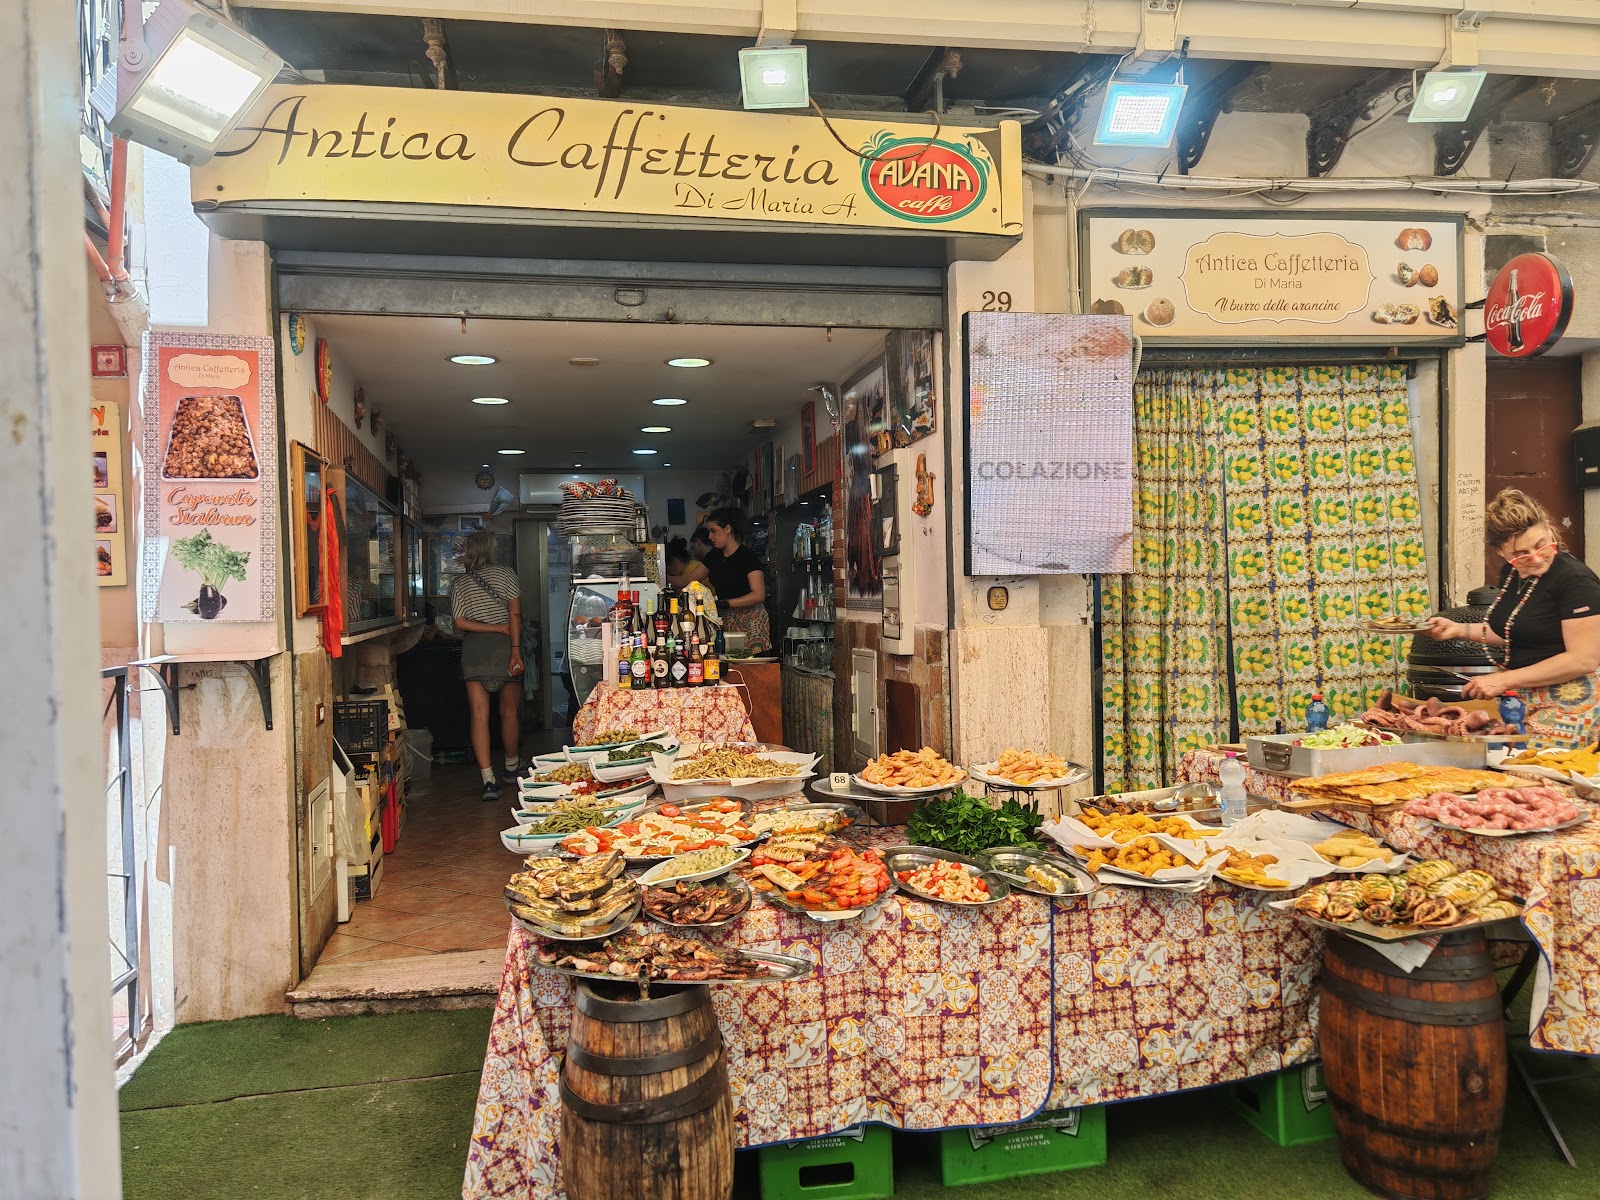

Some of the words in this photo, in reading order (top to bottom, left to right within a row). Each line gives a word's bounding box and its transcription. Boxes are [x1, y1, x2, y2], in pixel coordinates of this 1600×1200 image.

[214, 95, 476, 165] Antica
[507, 107, 839, 199] Caffetteria
[878, 159, 974, 192] AVANA
[674, 182, 714, 209] Di
[722, 187, 815, 216] Maria
[821, 193, 858, 218] A.
[1195, 253, 1258, 274] Antica
[1264, 252, 1359, 275] Caffetteria
[1254, 277, 1266, 289] Di
[1270, 278, 1302, 289] Maria
[981, 290, 1013, 312] 29
[1229, 299, 1261, 311] burro
[1262, 299, 1290, 311] delle
[1291, 299, 1341, 312] arancine
[173, 363, 201, 372] Antica
[977, 461, 1128, 480] COLAZIONE
[166, 486, 258, 511] Caponata
[169, 507, 257, 526] Siciliana
[834, 775, 846, 784] 68
